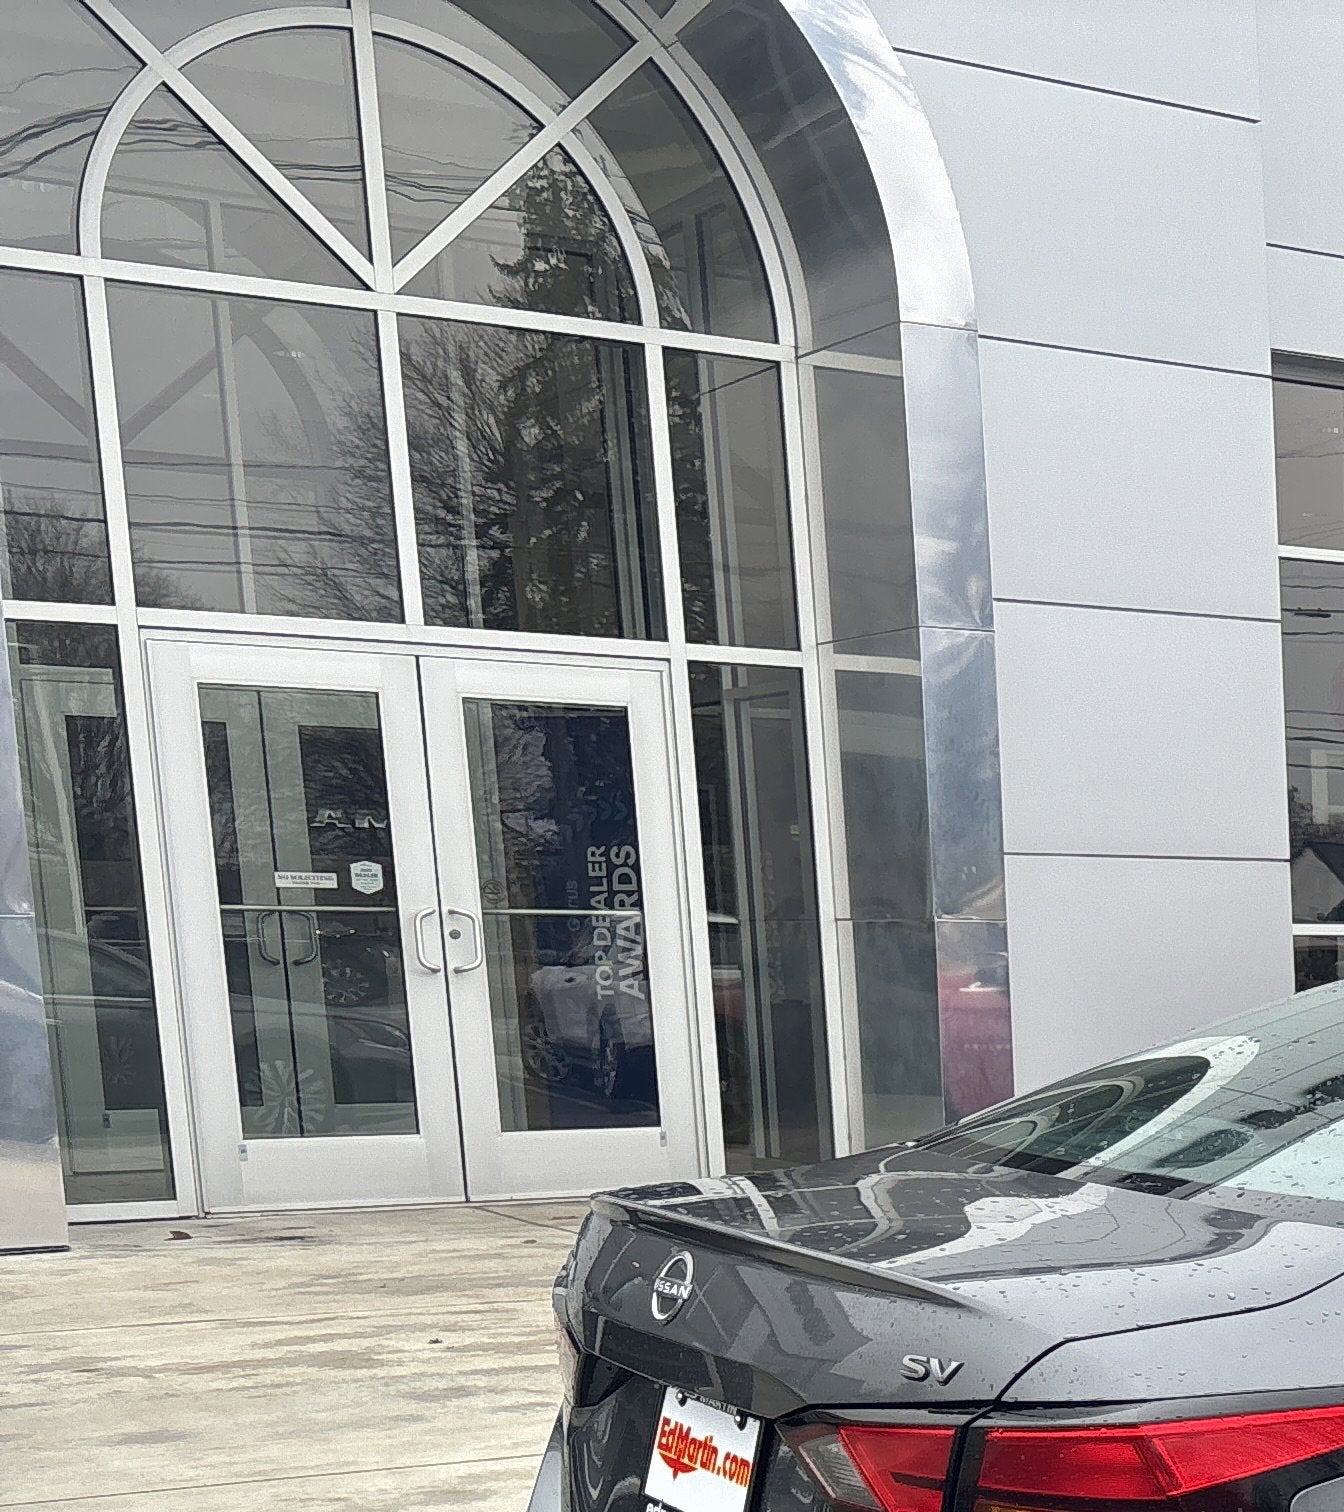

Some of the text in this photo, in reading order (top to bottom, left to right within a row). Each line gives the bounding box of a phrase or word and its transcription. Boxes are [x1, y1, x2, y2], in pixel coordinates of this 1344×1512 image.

[587, 845, 615, 1001] TOP DEALER
[610, 844, 645, 1000] AWARDS
[900, 1354, 965, 1386] SV
[656, 1415, 751, 1488] EdMartin.com
